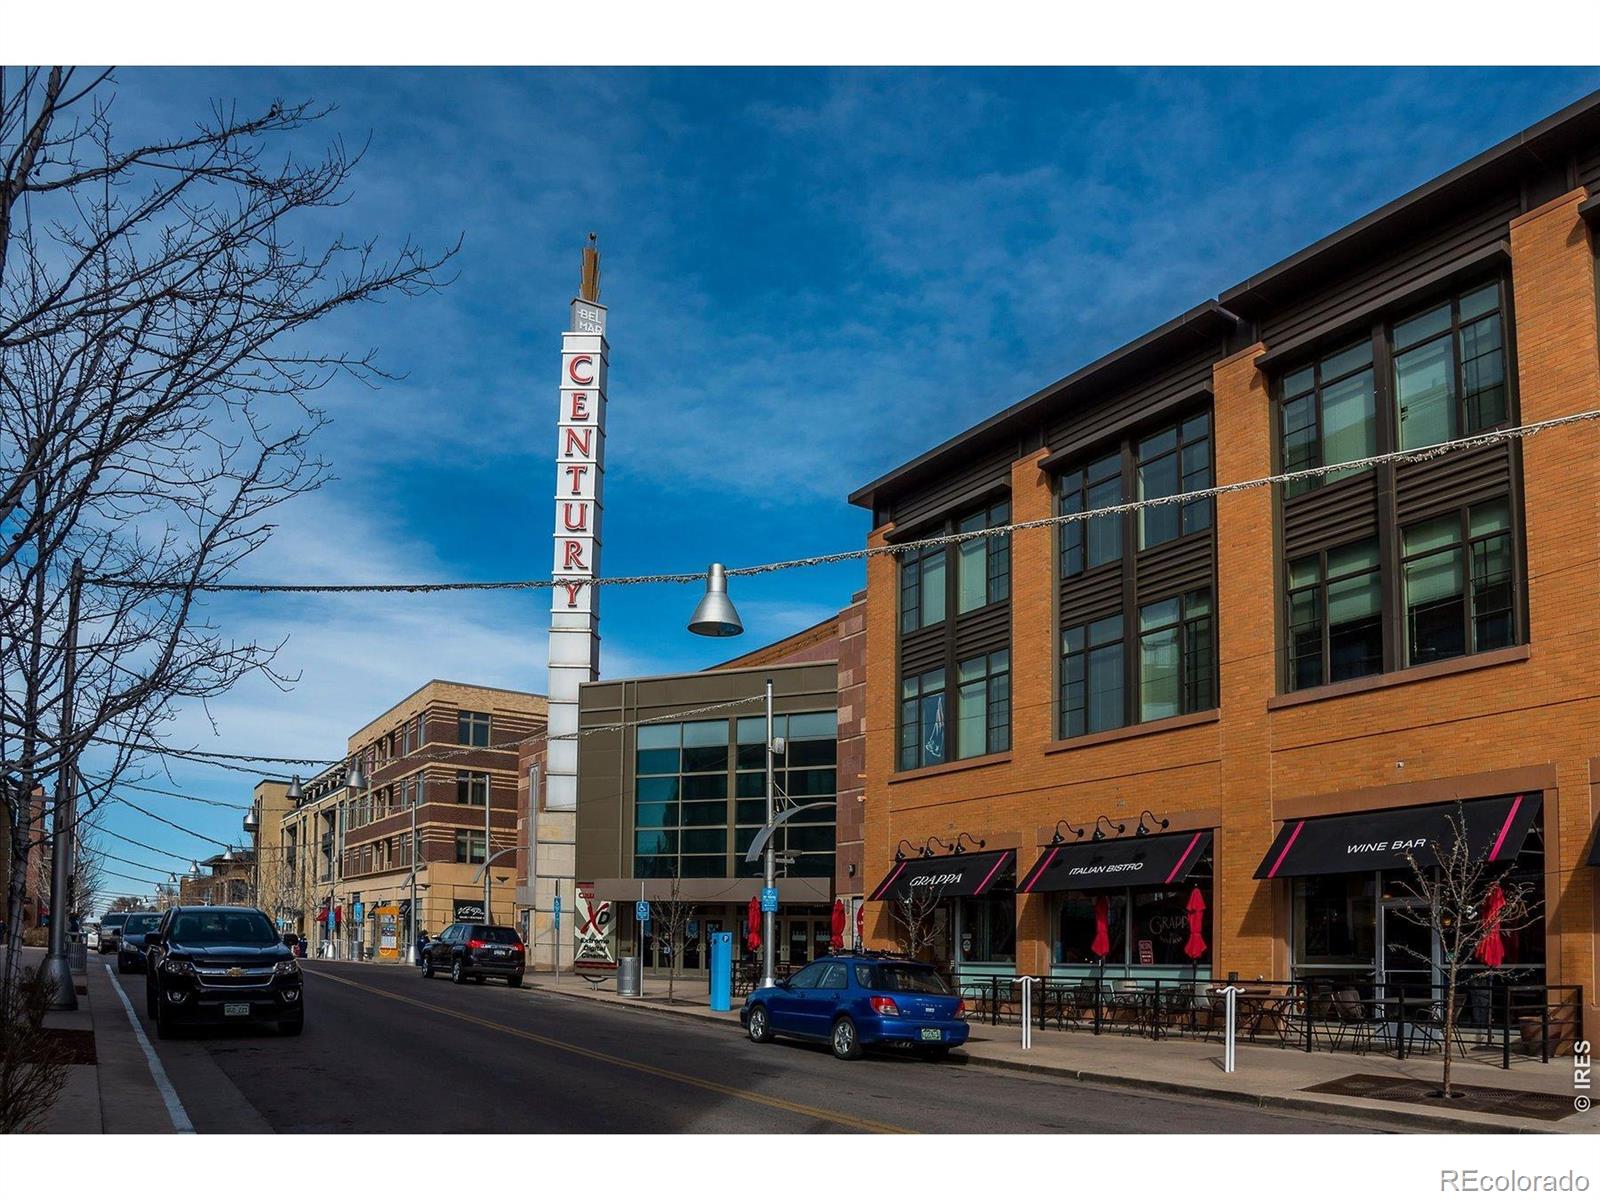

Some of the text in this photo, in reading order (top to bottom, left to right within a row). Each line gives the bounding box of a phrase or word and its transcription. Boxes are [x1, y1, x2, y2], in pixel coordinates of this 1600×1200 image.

[563, 354, 594, 608] CENTURY
[1347, 838, 1426, 854] WINE BAR
[1068, 862, 1143, 875] ITALIAN BISTRO
[909, 873, 962, 886] GRAPPA
